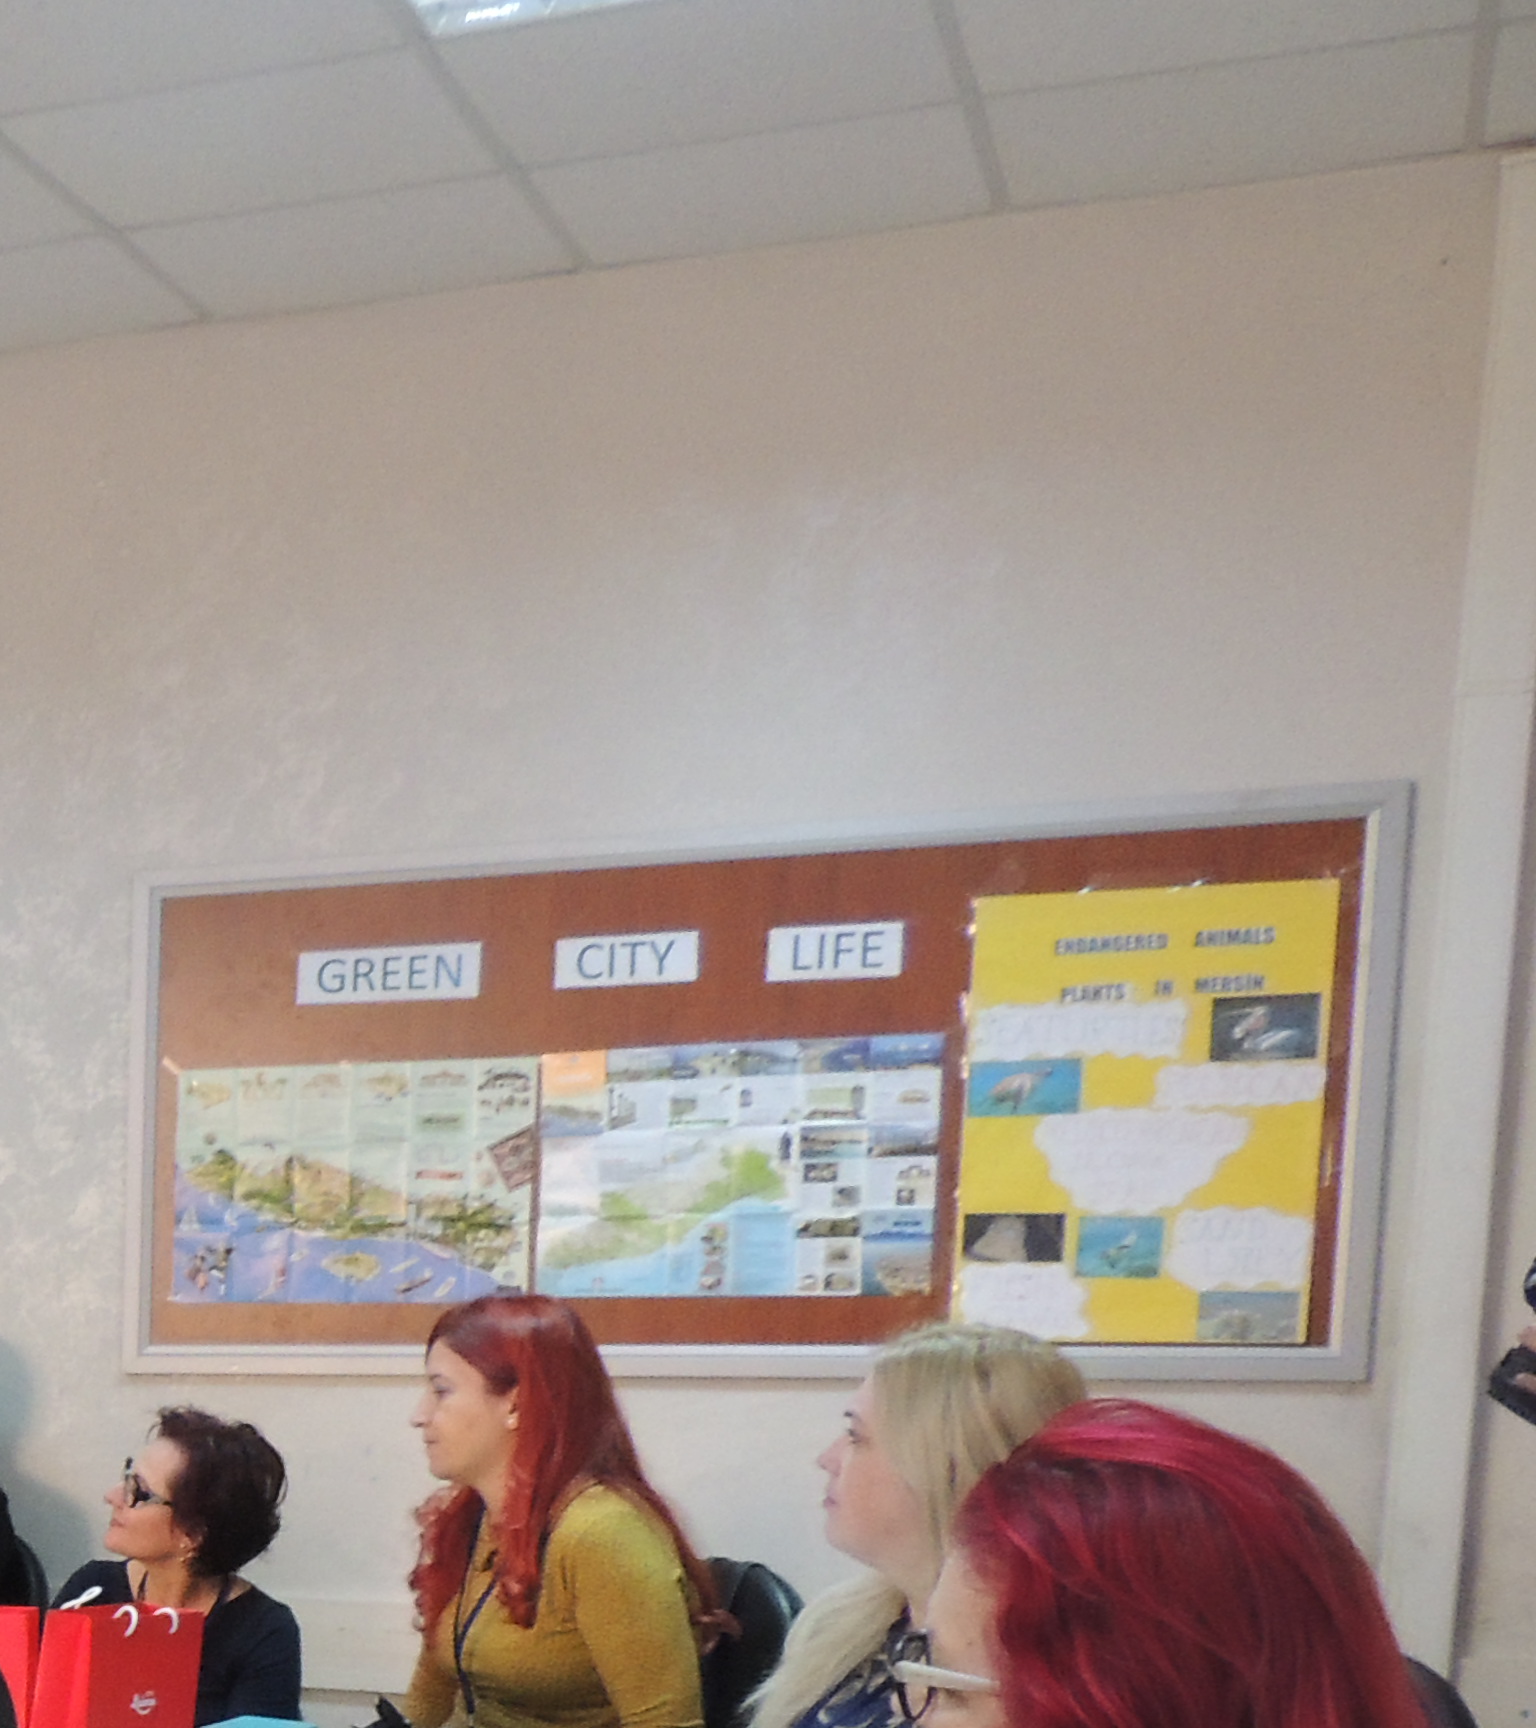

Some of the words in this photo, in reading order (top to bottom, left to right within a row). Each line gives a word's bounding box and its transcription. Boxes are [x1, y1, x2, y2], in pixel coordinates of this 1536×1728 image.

[1055, 933, 1169, 956] ENDANGERED
[1194, 926, 1276, 948] ANIMALS
[317, 953, 463, 994] GREEN
[575, 940, 677, 981] CITY
[790, 930, 886, 971] LIFE
[1061, 983, 1126, 1003] PLANTS
